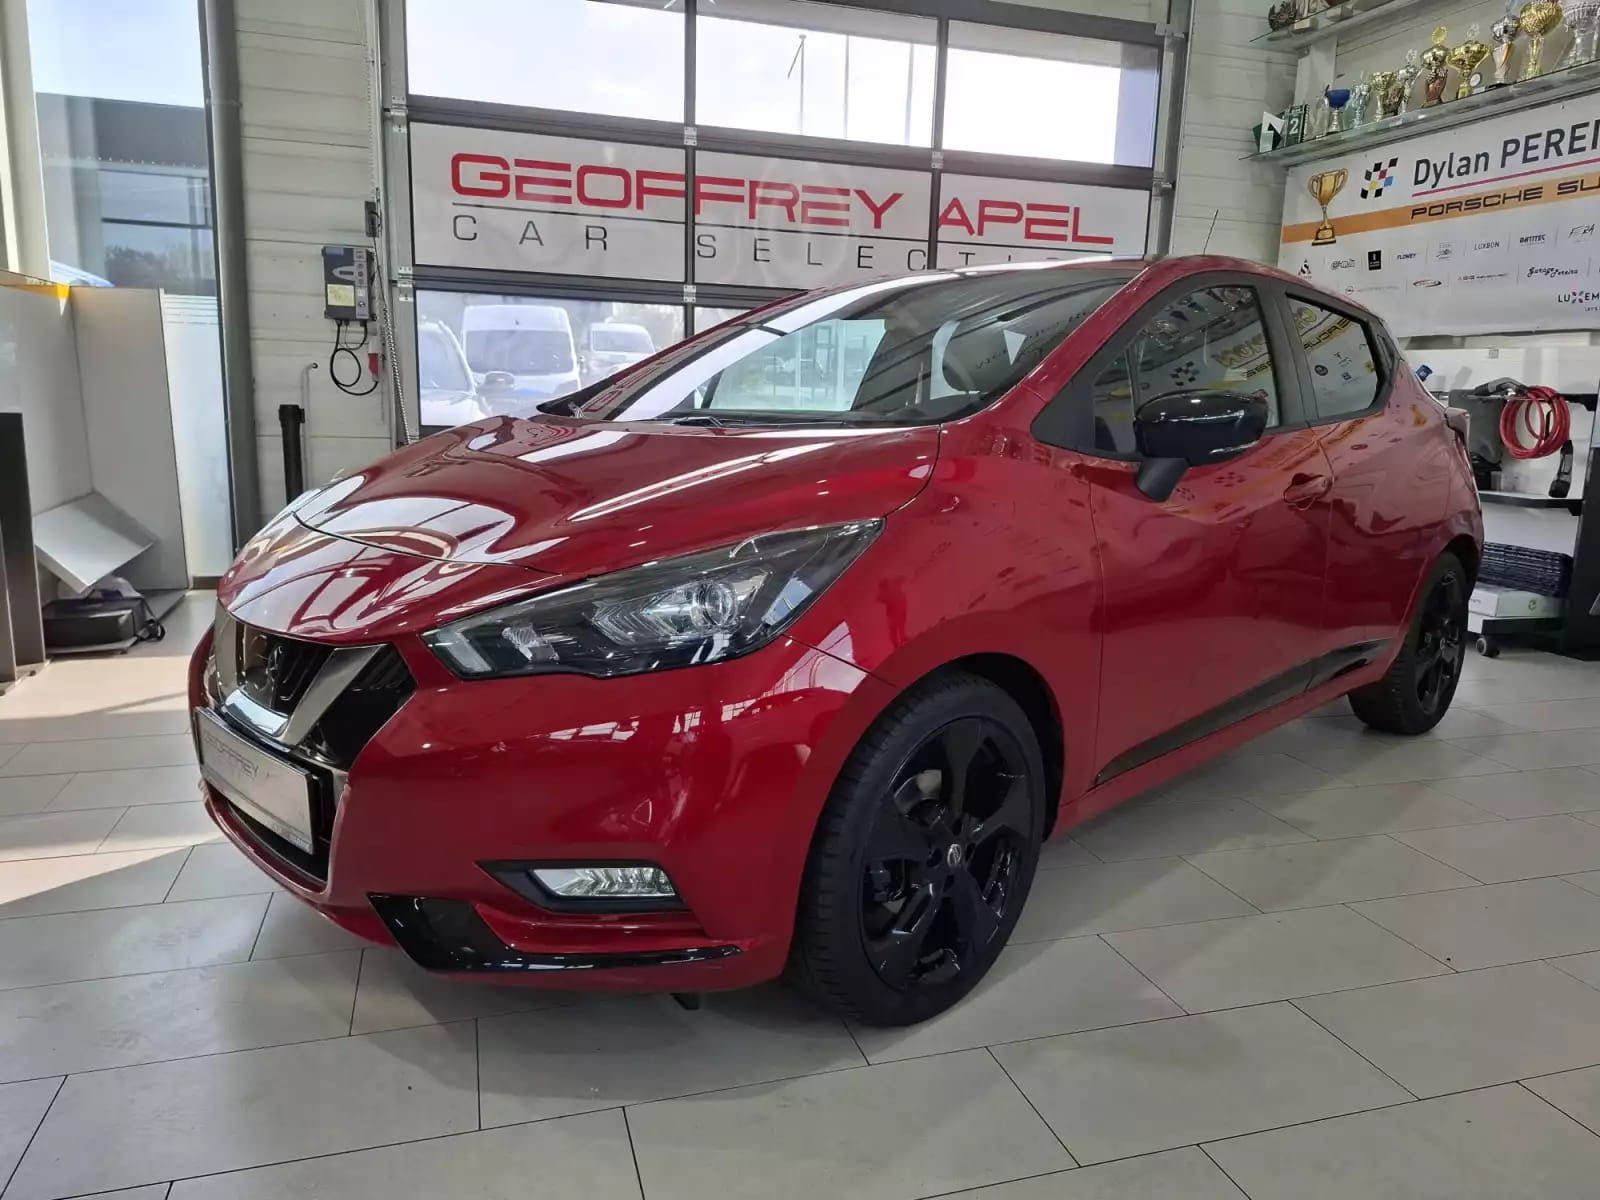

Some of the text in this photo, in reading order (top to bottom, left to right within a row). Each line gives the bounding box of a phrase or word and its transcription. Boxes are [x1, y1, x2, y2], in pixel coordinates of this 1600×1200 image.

[1289, 117, 1299, 135] 2
[1414, 151, 1490, 188] Dylan
[451, 153, 1114, 245] GEOFFREY APEL
[1411, 186, 1543, 219] PORSCHE
[453, 214, 1061, 271] CAR SELECT
